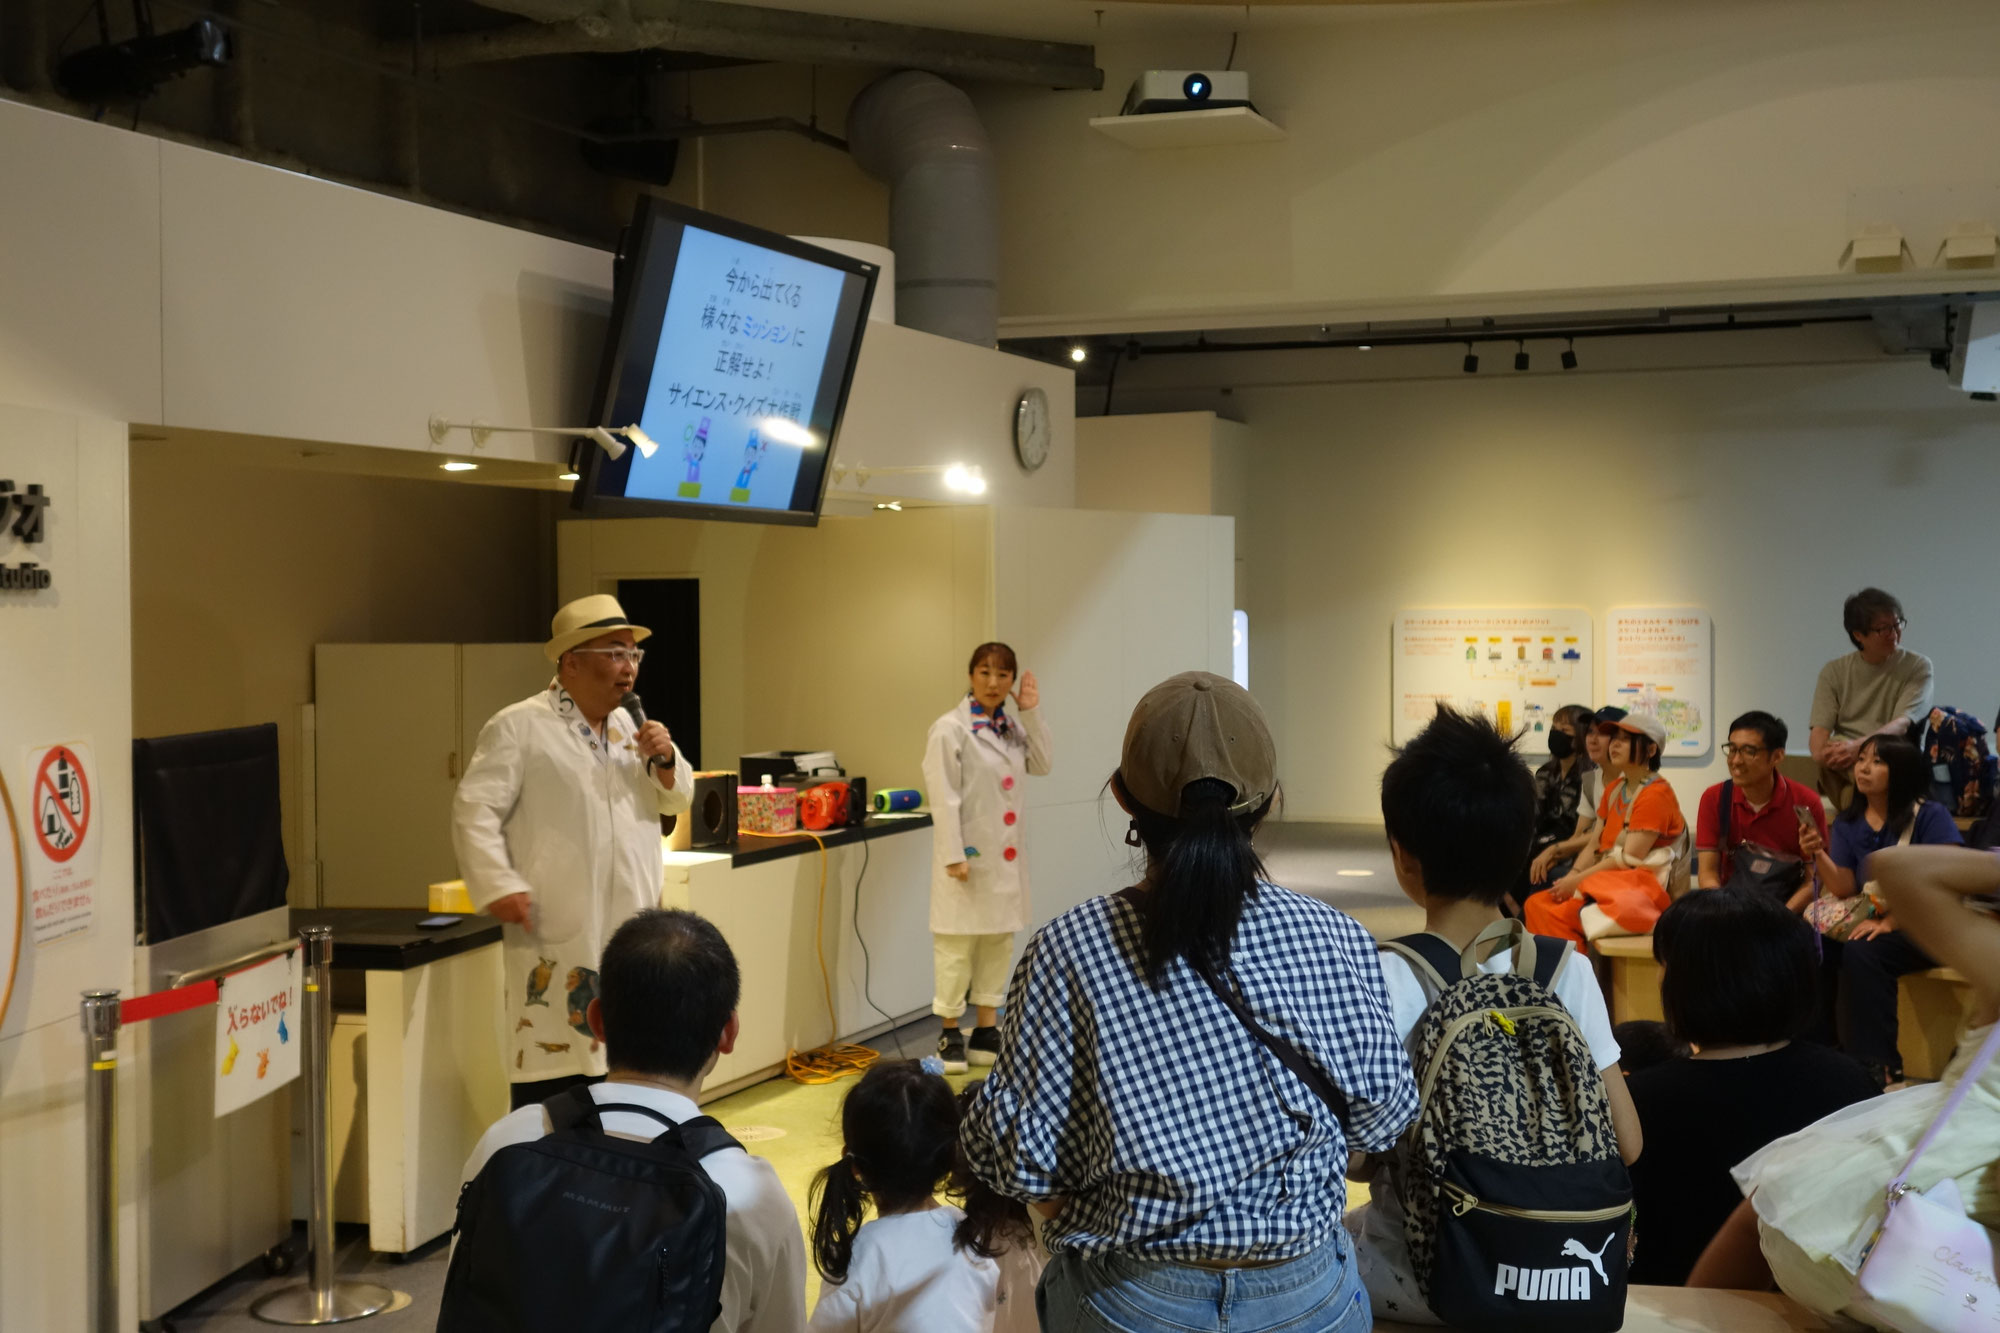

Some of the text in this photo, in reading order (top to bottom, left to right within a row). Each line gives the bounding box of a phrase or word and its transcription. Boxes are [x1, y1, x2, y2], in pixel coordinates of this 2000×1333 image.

[725, 267, 802, 308] 今から出てくる
[1494, 1263, 1591, 1301] PUMA
